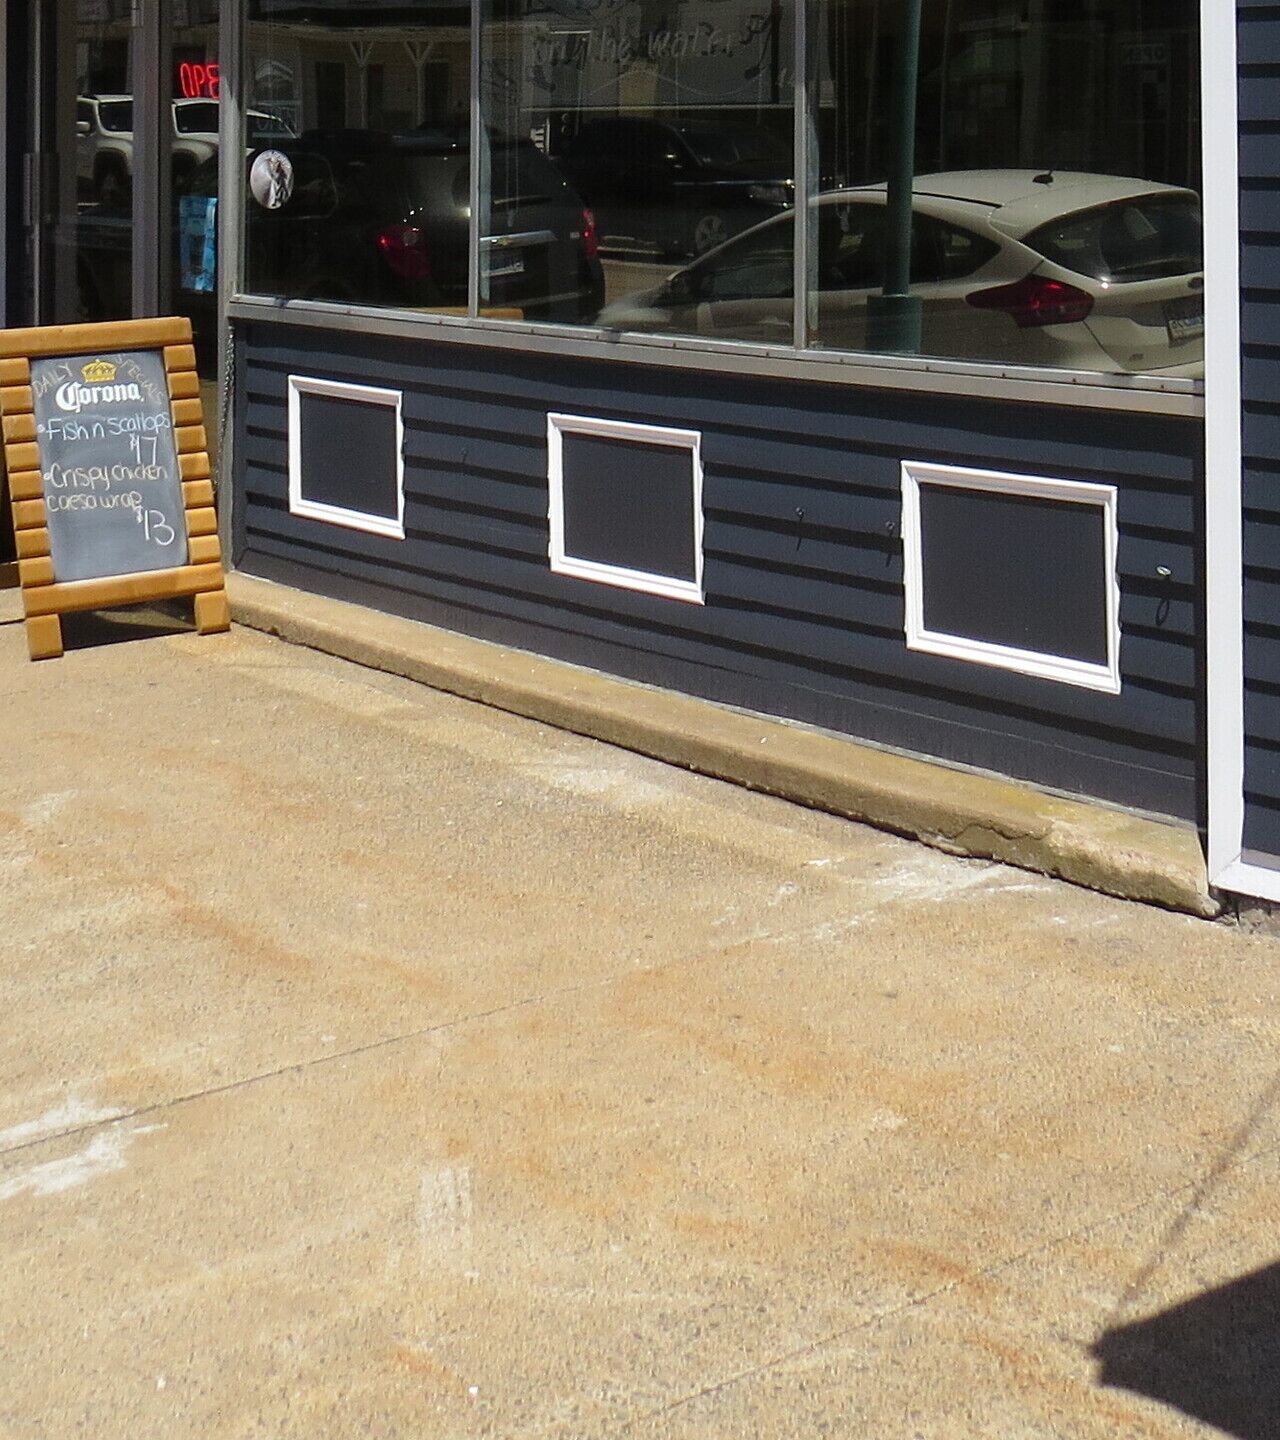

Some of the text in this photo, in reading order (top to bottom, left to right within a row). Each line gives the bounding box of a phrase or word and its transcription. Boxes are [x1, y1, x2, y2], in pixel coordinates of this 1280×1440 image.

[181, 63, 220, 98] OPE
[55, 381, 144, 413] Corona
[46, 418, 89, 440] Fish
[93, 422, 106, 439] n
[51, 463, 110, 491] Crispy
[98, 491, 143, 509] wrap
